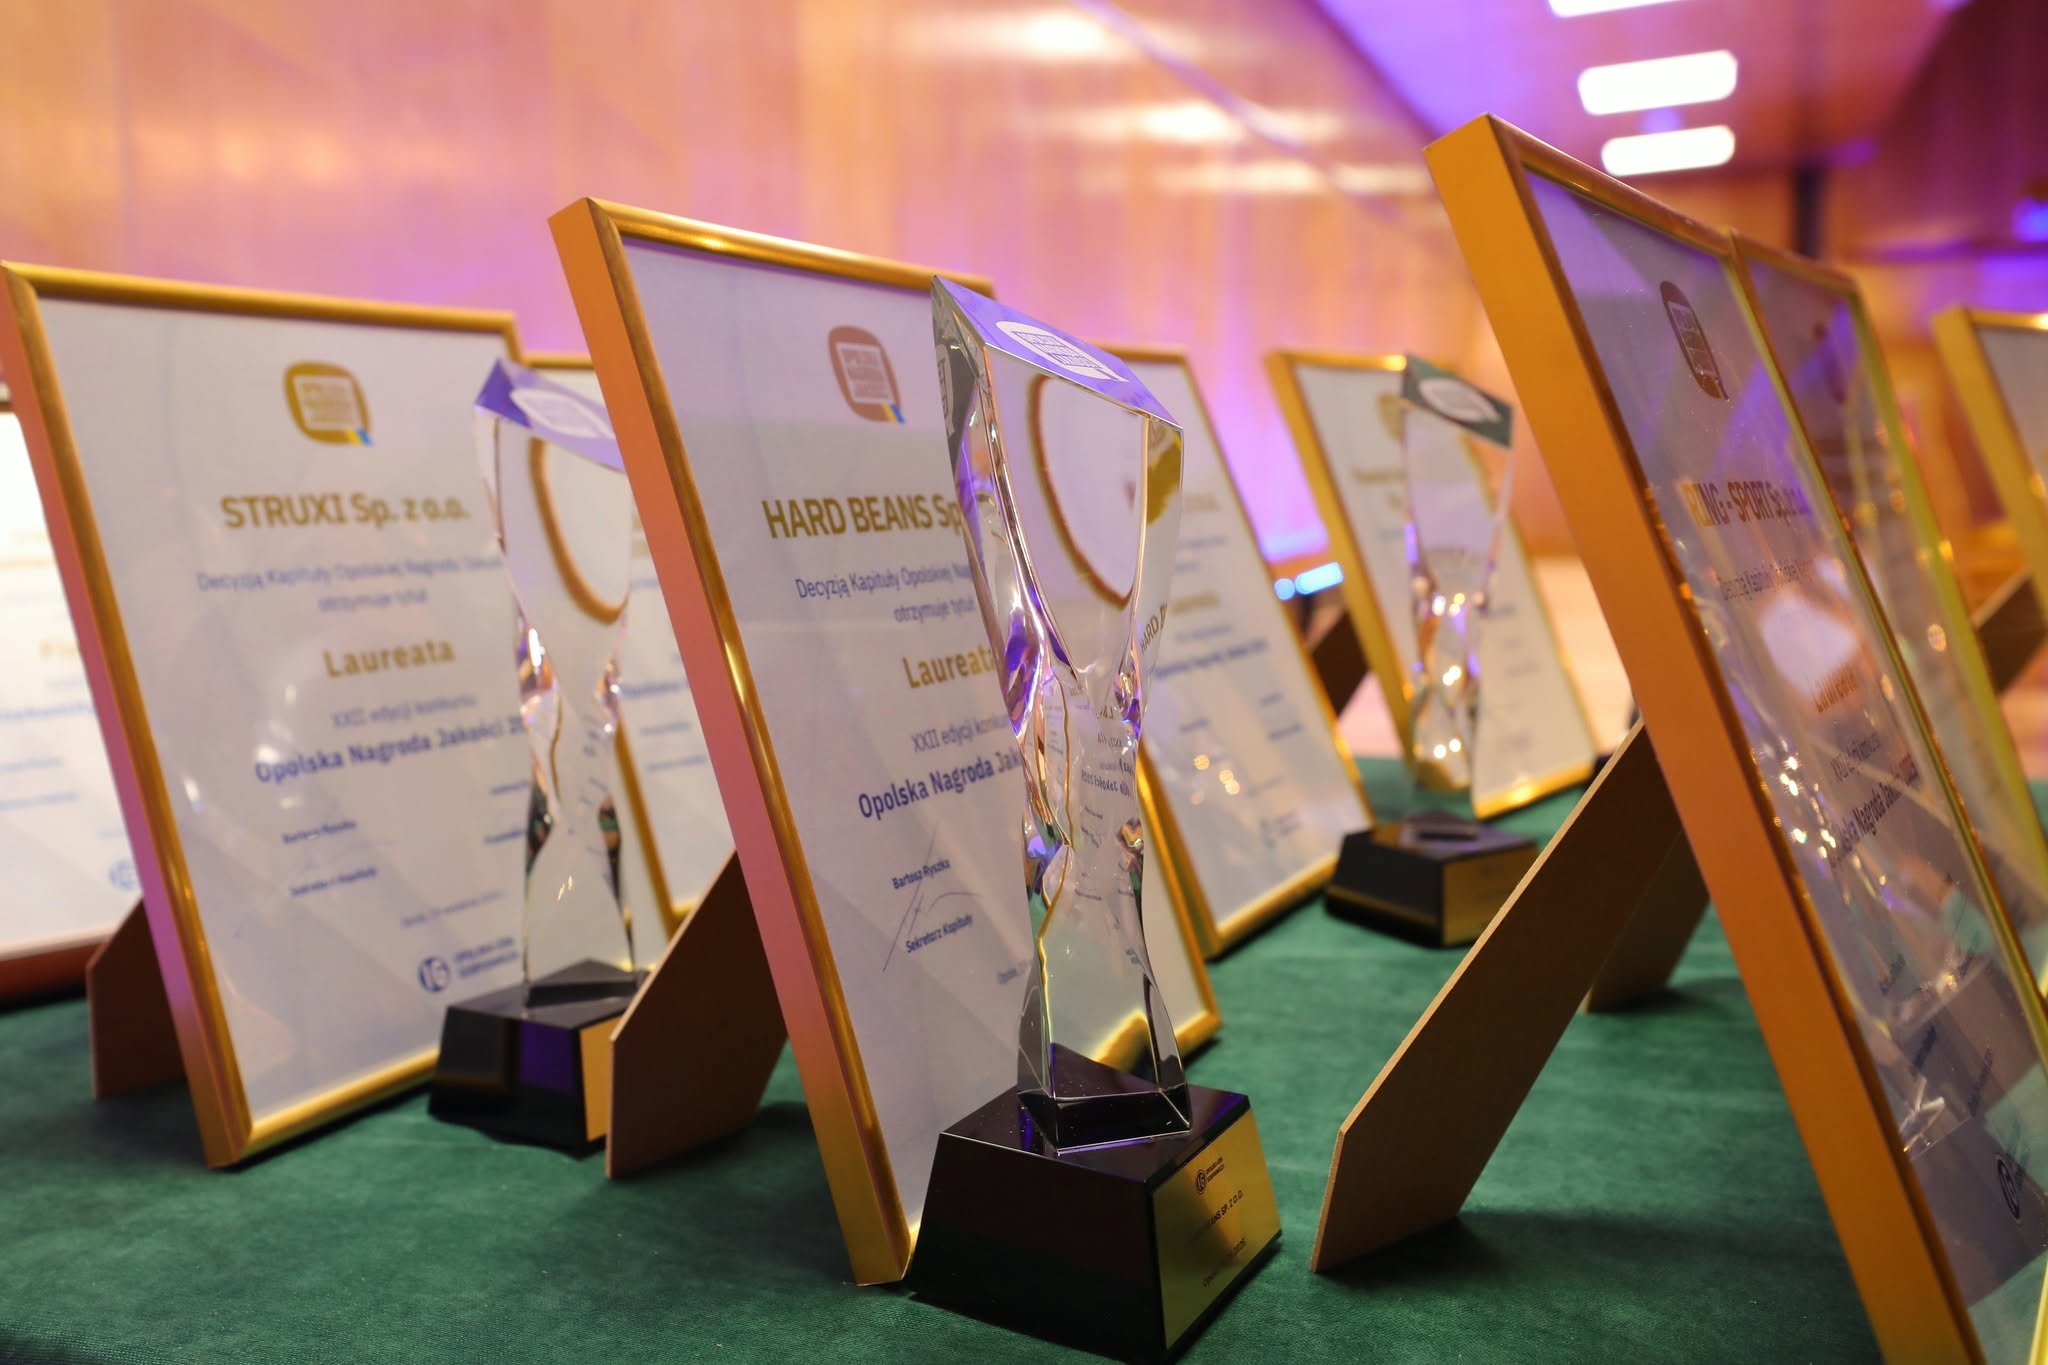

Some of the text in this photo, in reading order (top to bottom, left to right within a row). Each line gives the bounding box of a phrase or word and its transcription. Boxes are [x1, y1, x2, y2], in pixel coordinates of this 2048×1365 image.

[220, 493, 349, 529] STRUXI
[351, 493, 398, 530] Sp.
[404, 497, 418, 521] z
[762, 497, 847, 539] HARD
[847, 494, 933, 533] BEANS
[795, 574, 851, 600] Decyzją
[323, 639, 456, 678] Laureata
[254, 750, 344, 784] Opolska
[348, 733, 432, 764] Nagroda
[858, 778, 930, 821] Opolska
[929, 755, 995, 794] Nagroda
